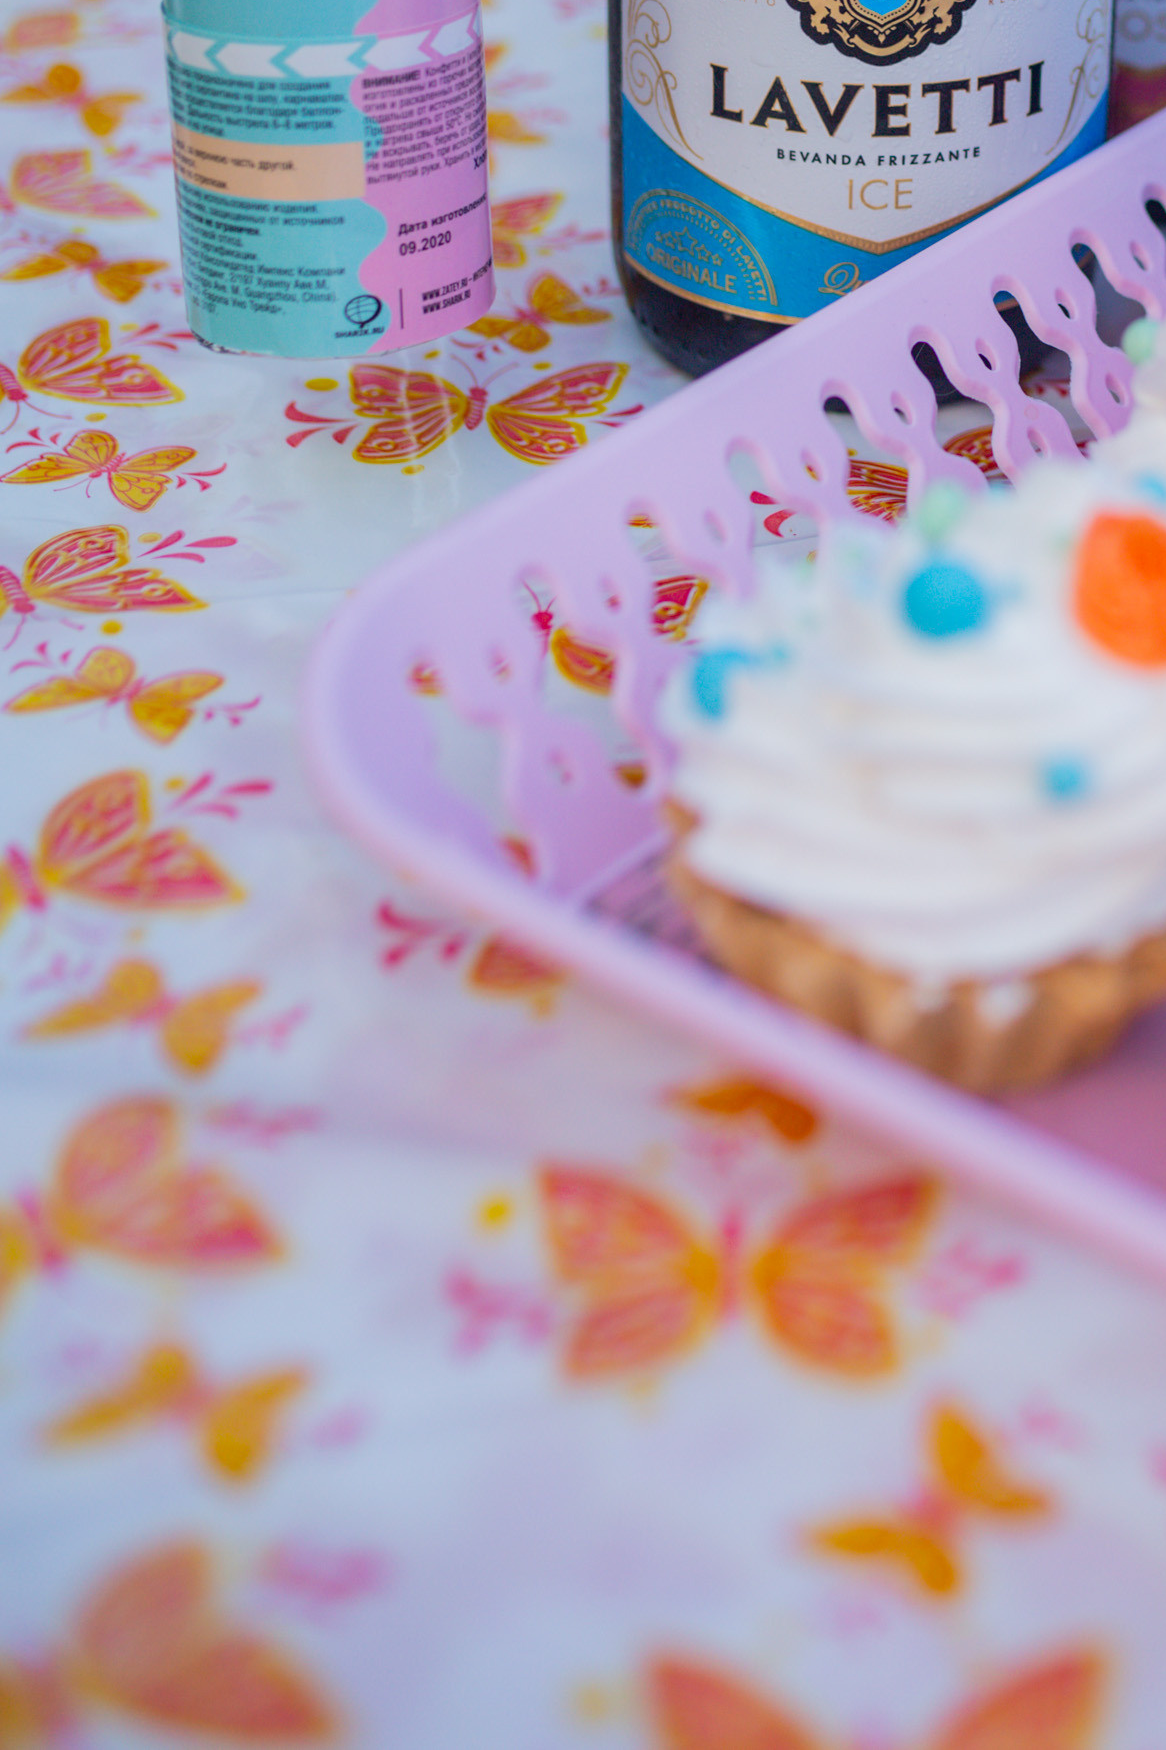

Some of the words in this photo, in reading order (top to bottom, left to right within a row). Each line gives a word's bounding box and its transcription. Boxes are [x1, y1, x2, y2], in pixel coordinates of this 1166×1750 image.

[709, 60, 1046, 138] LAVETTI
[776, 147, 866, 167] BEVANDA
[877, 146, 982, 167] FRIZZANTE
[847, 178, 914, 212] ICE
[397, 219, 429, 237] Дата
[398, 230, 453, 257] 09.2020
[660, 197, 721, 231] PRODOTTO
[722, 228, 737, 245] DI
[735, 244, 768, 302] LAVETTI
[645, 241, 738, 295] ORIGINALE
